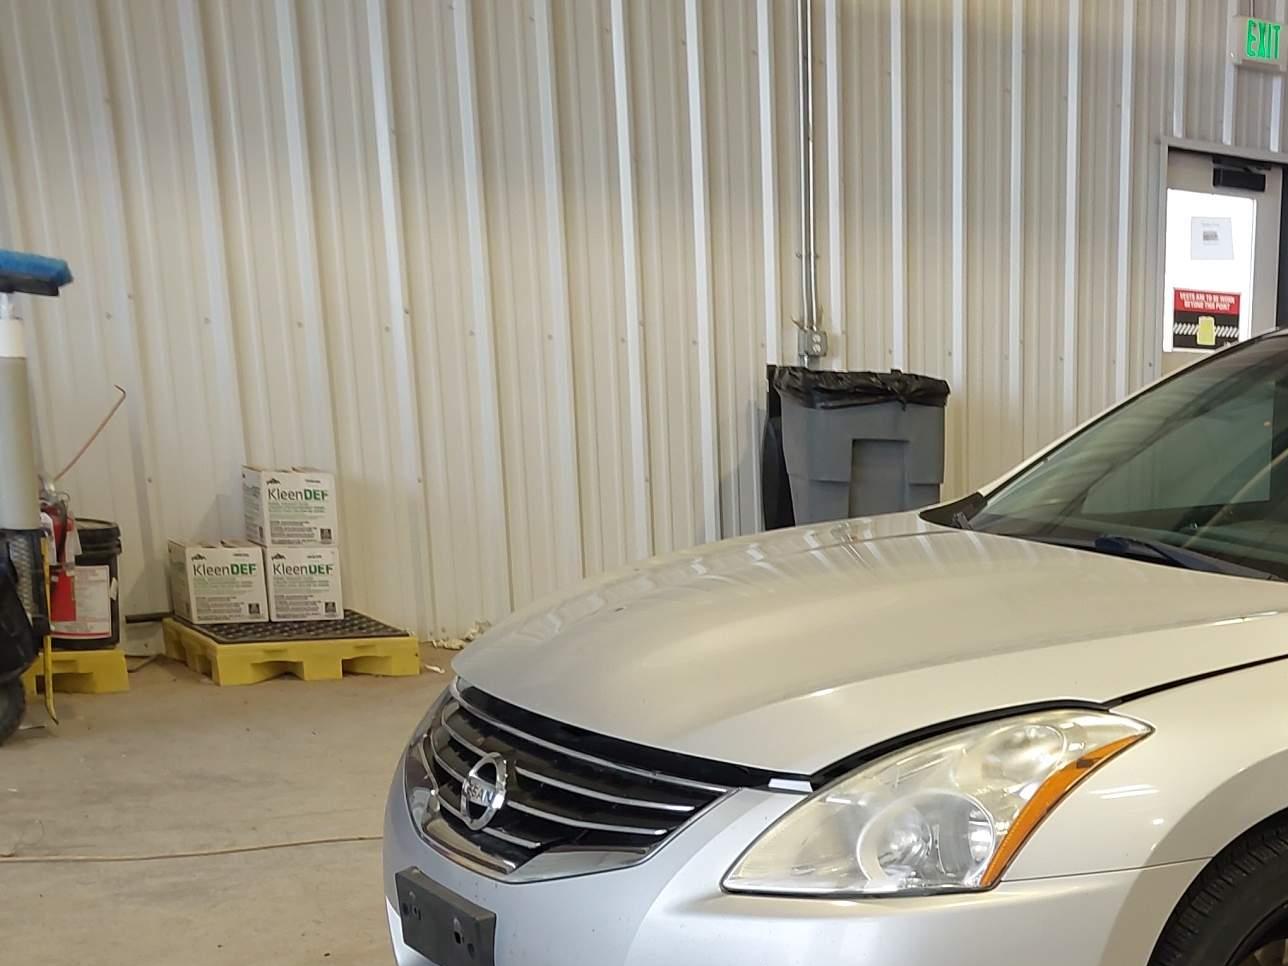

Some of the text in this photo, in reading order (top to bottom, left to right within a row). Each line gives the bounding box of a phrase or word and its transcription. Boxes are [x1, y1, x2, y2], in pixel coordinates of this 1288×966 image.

[1247, 20, 1280, 59] EXIT
[268, 488, 329, 500] KleenDEF
[193, 563, 257, 576] KleenDEF
[273, 563, 333, 576] KleenDEF
